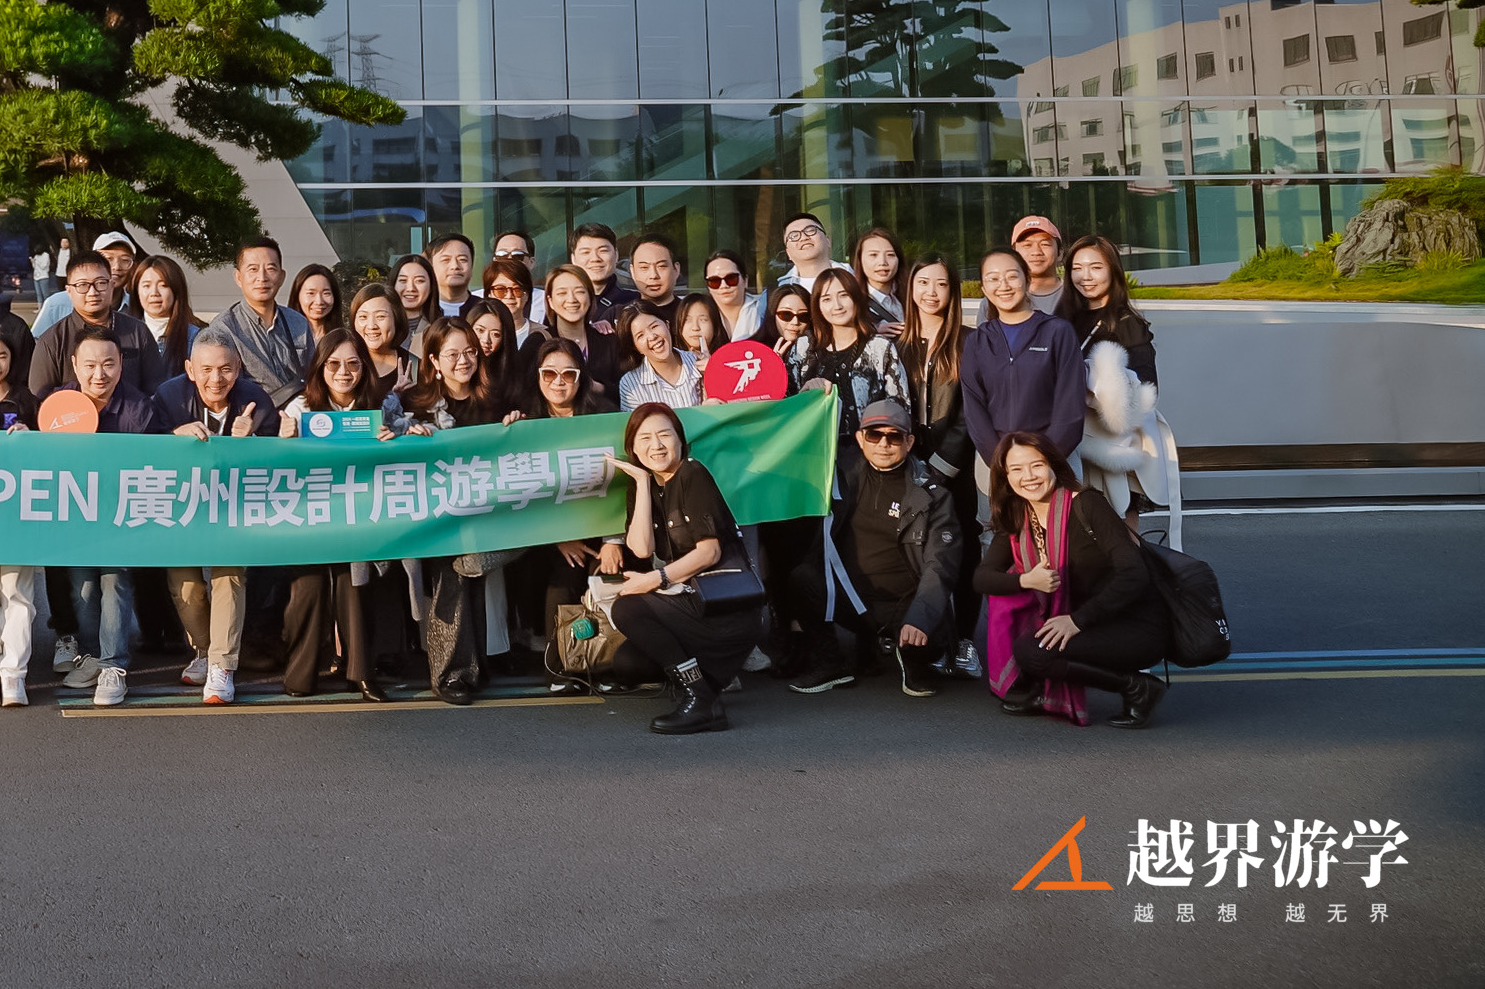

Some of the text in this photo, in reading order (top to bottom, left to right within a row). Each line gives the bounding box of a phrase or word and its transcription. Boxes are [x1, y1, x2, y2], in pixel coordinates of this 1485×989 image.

[114, 446, 615, 529] 廣州設計周遊學團
